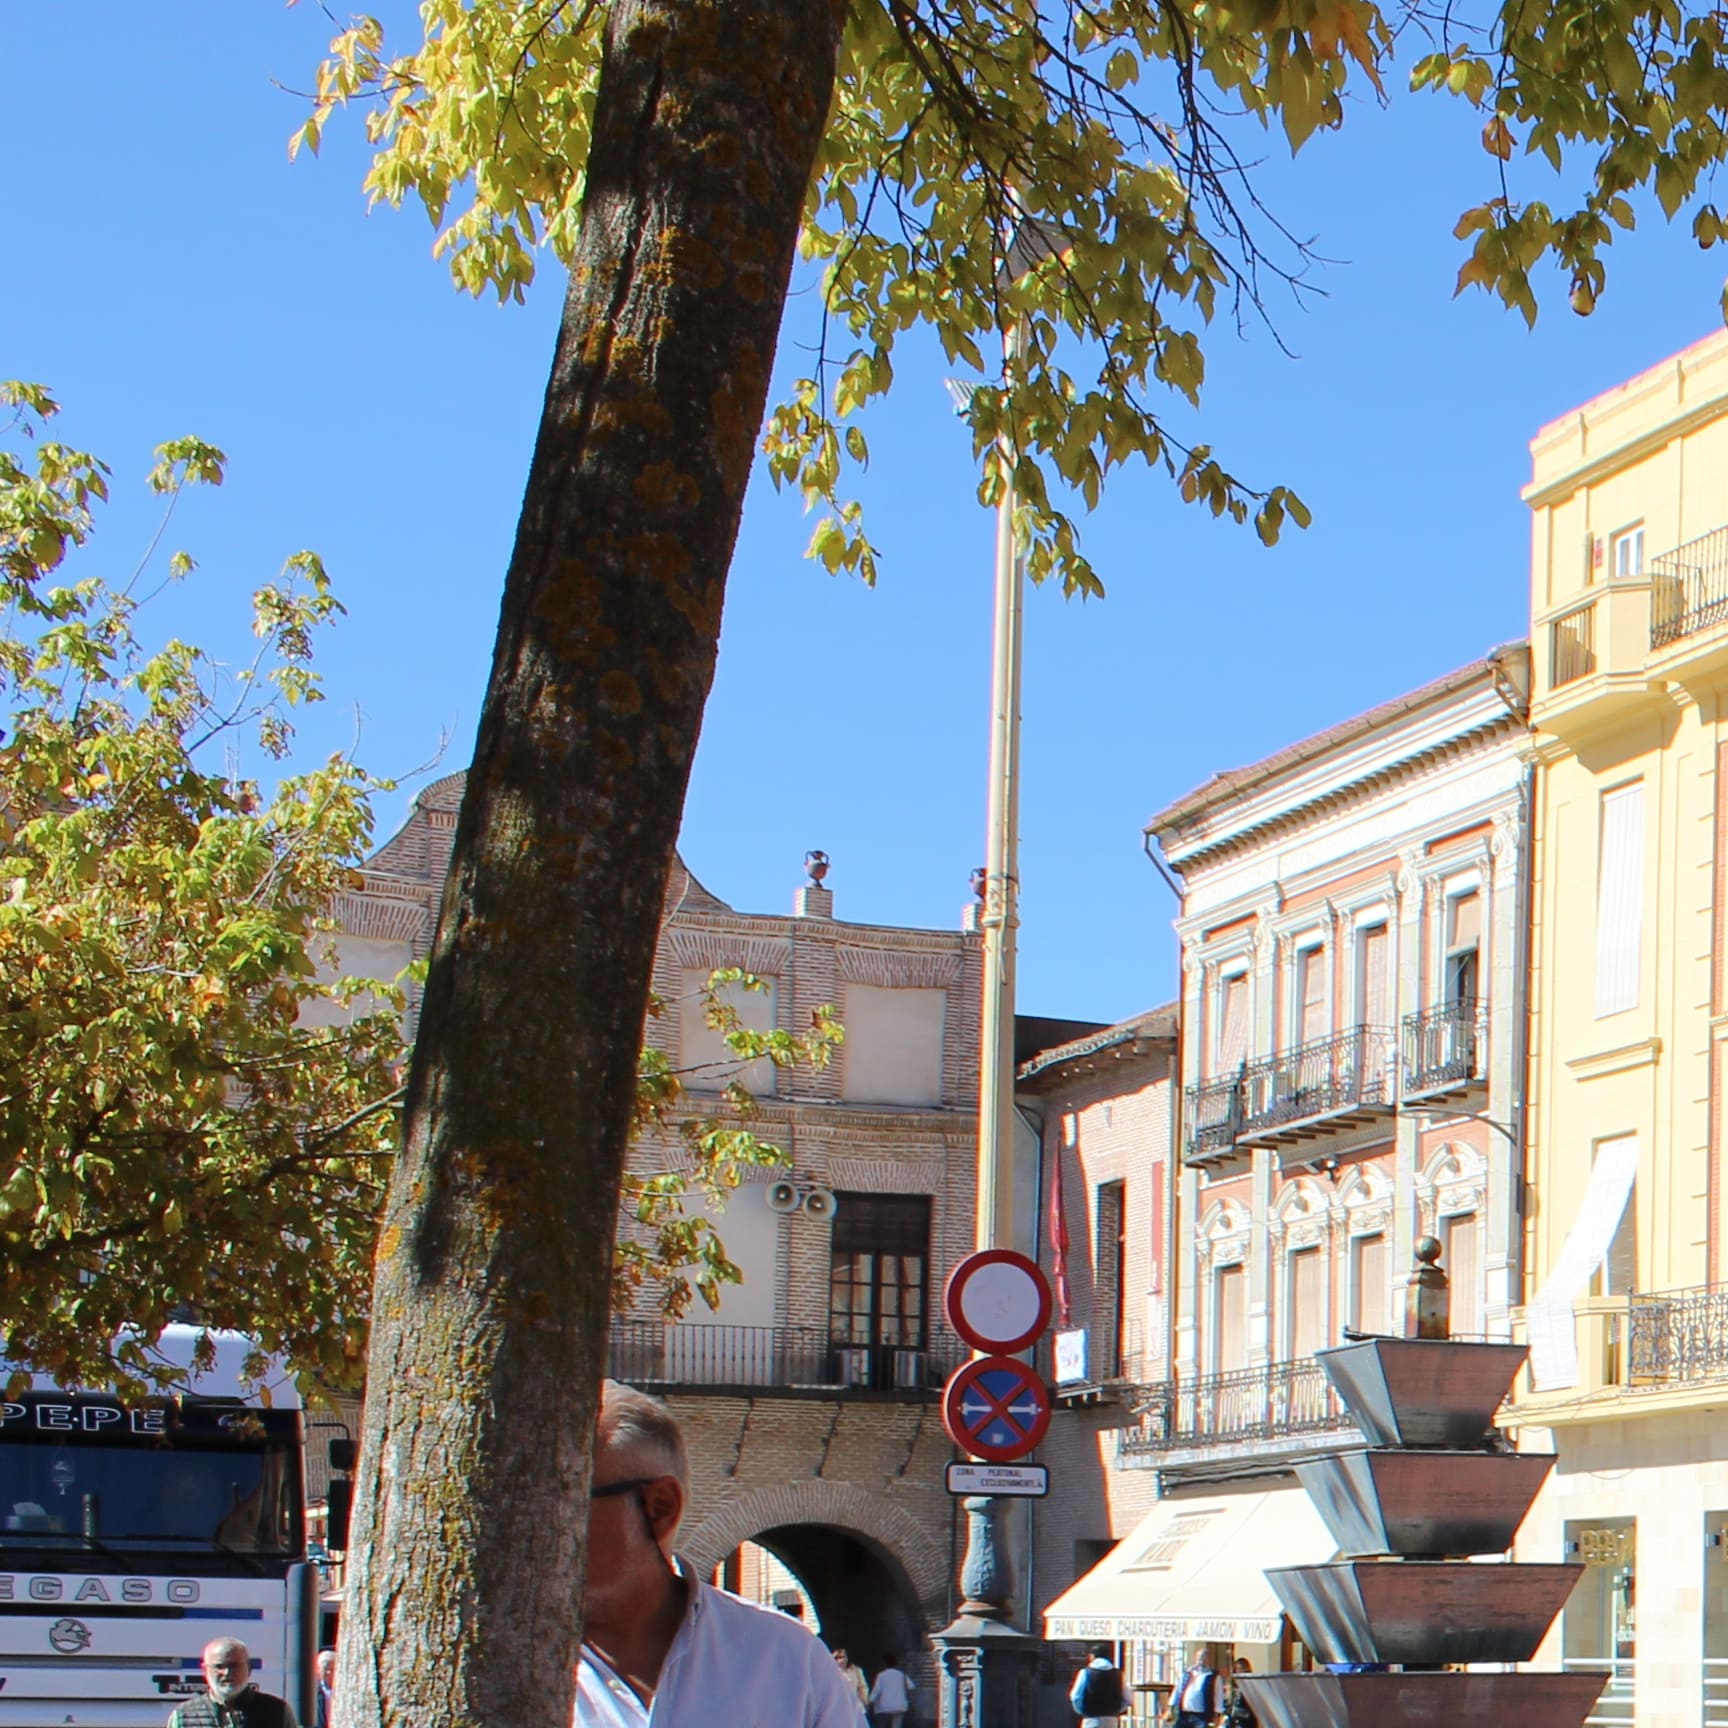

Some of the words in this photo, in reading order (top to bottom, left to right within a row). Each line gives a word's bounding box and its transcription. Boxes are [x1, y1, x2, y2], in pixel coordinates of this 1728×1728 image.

[1579, 1529, 1635, 1567] BBV
[1054, 1620, 1073, 1636] PAN
[1079, 1620, 1111, 1636] QUESO
[1118, 1620, 1187, 1638] CHARCUTERIA
[1244, 1623, 1272, 1640] VINO
